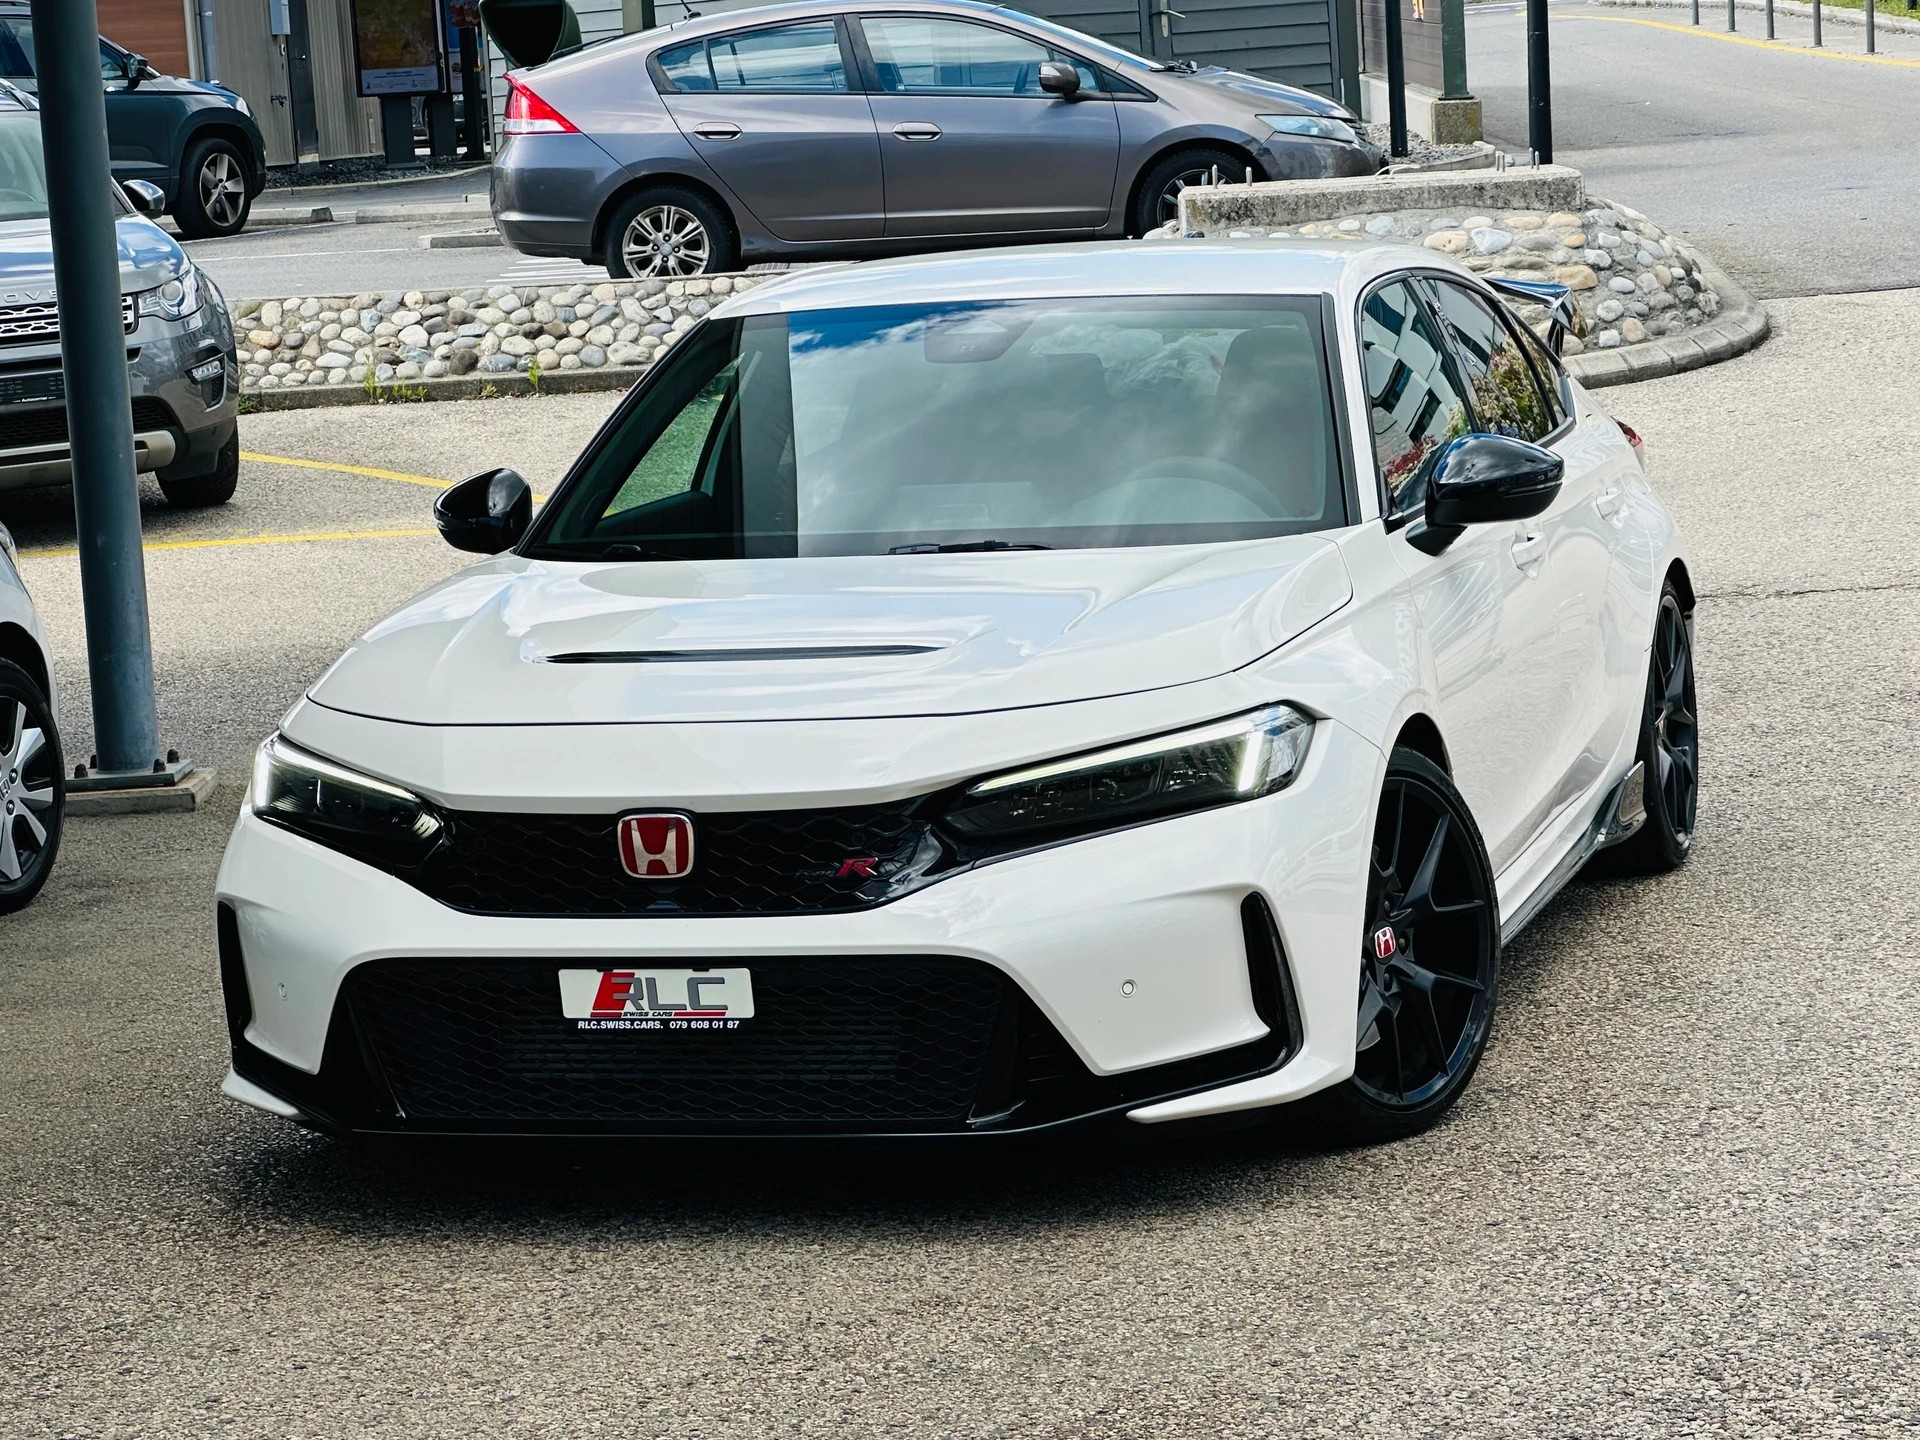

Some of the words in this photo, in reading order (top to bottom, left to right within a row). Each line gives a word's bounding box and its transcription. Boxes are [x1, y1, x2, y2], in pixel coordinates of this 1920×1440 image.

[3, 289, 57, 303] OVE
[837, 857, 878, 877] R
[610, 977, 729, 1011] RLC
[577, 1020, 664, 1030] RLC.SWISS.CARS.
[669, 1020, 688, 1030] 079
[690, 1020, 710, 1030] 608
[712, 1020, 724, 1030] 01
[726, 1020, 740, 1030] 87
